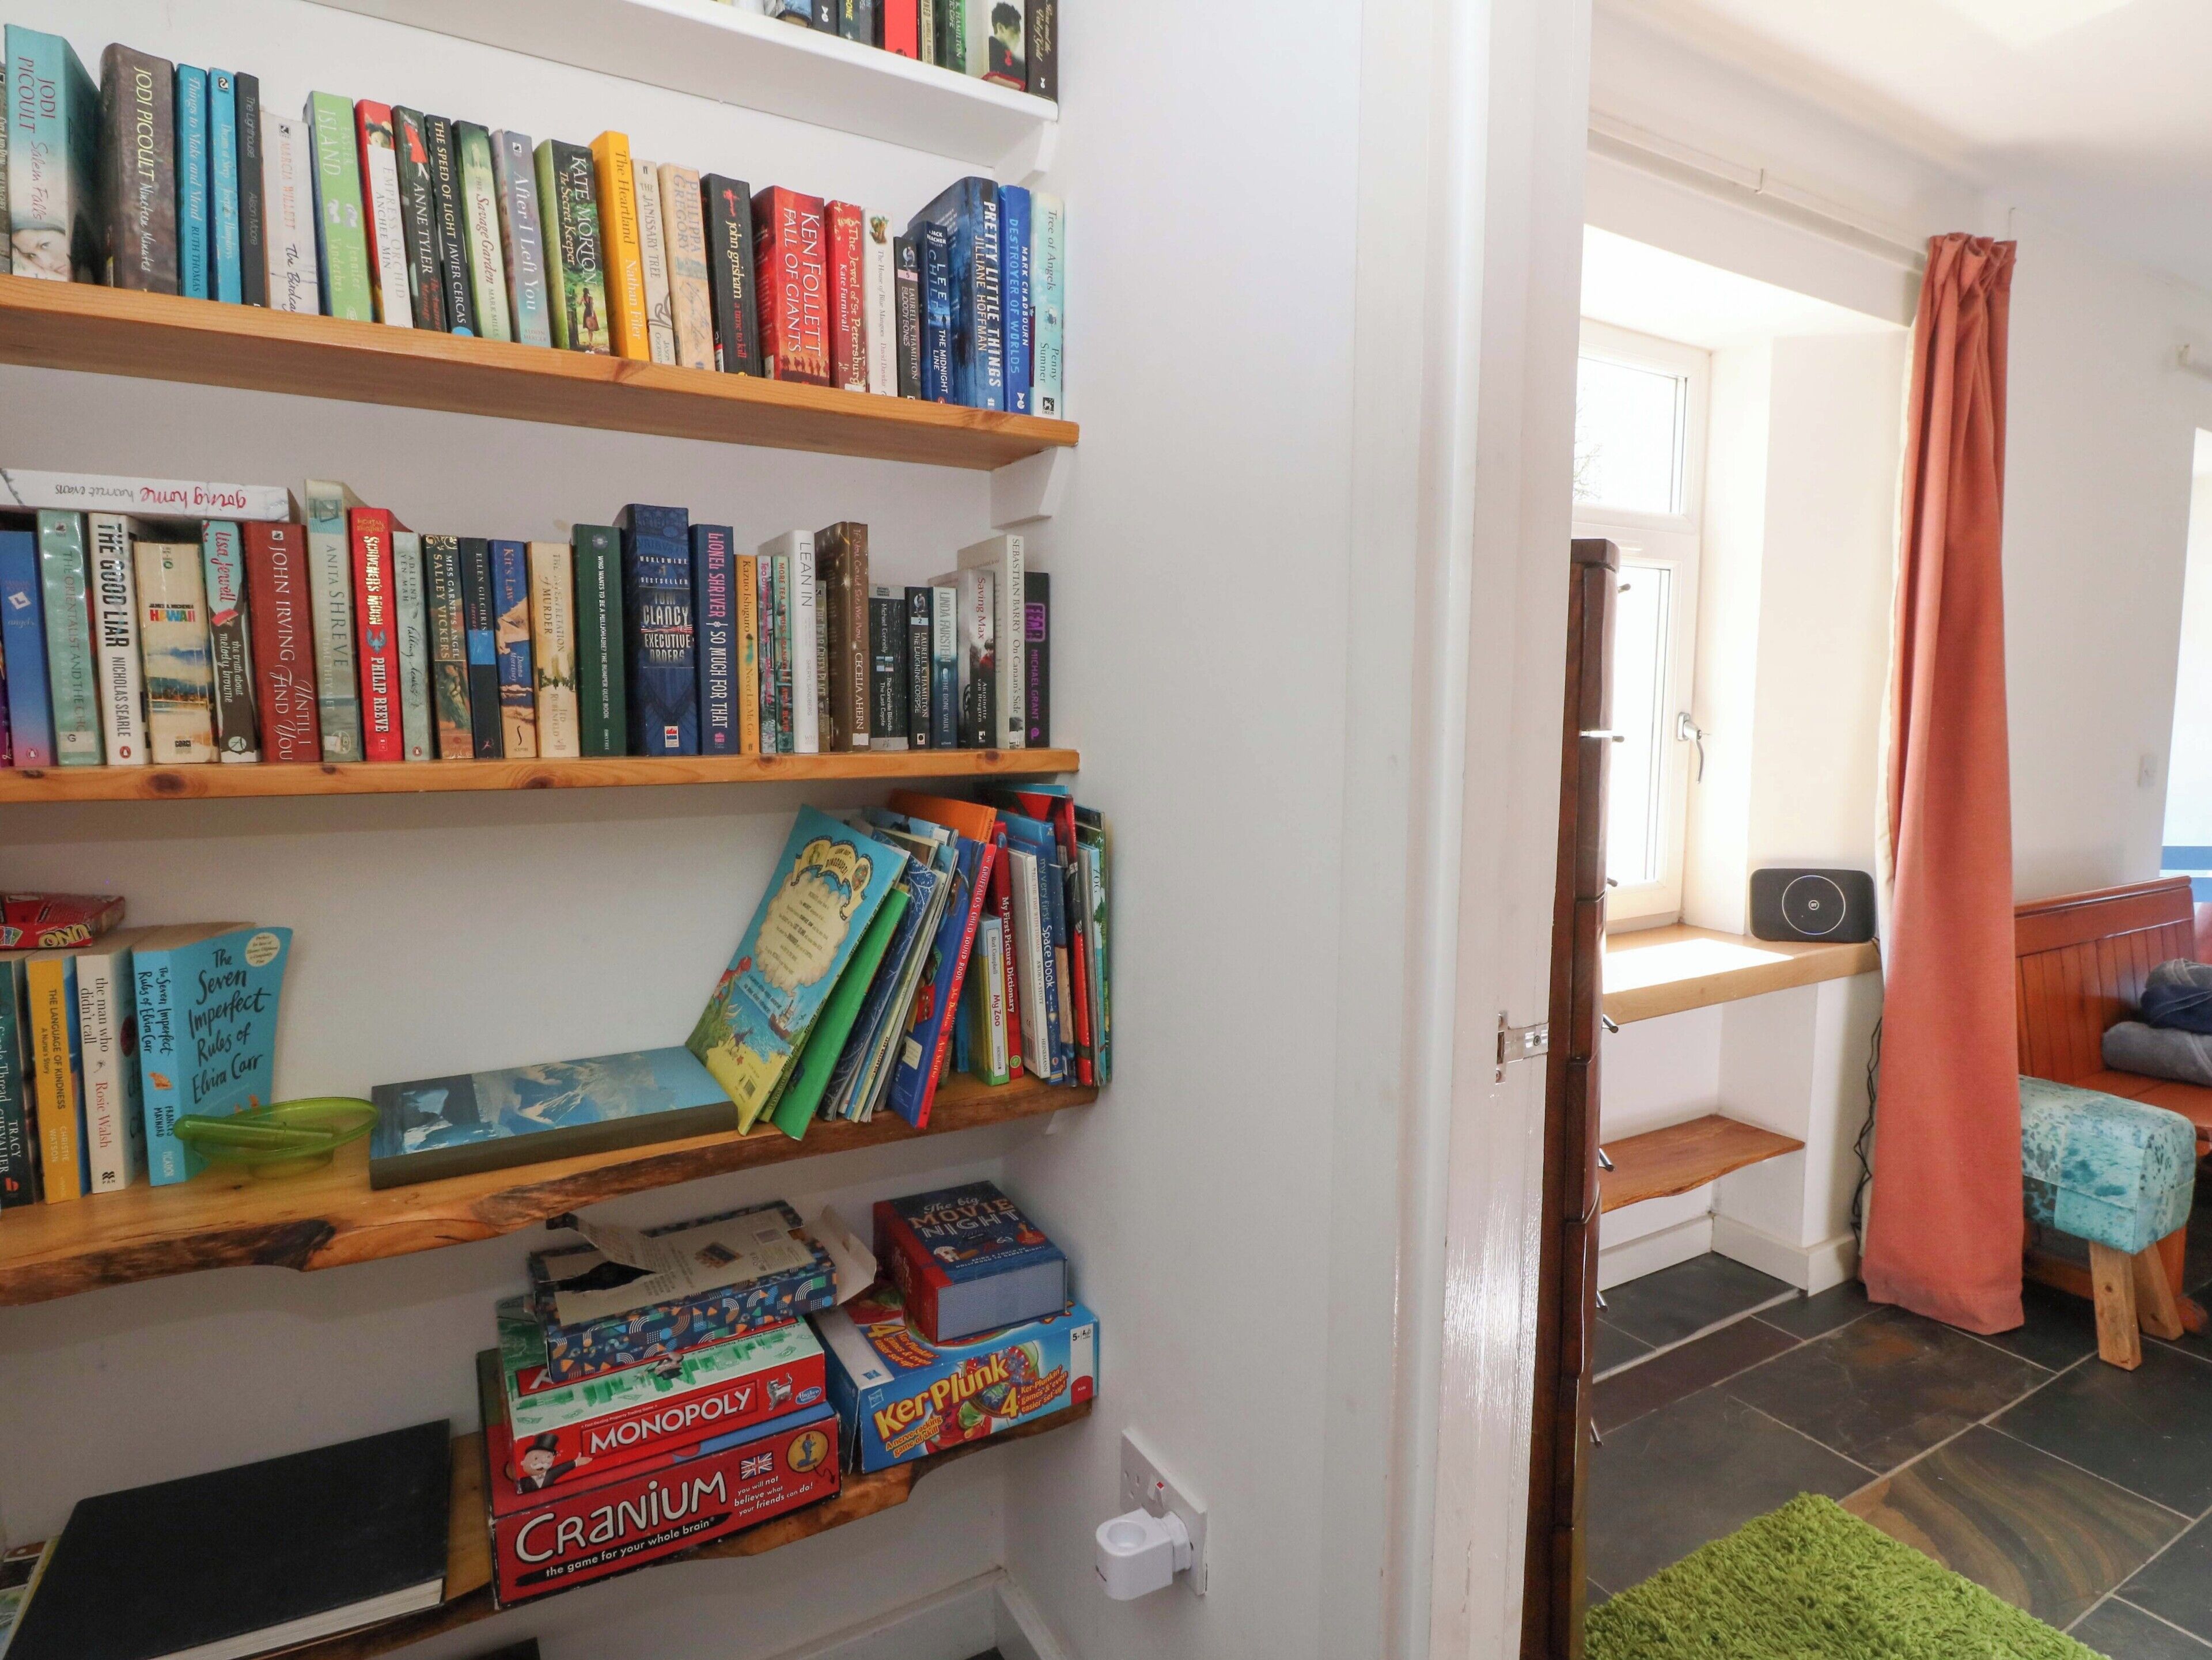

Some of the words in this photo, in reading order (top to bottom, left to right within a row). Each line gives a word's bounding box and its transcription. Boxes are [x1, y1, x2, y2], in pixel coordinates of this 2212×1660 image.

[18, 56, 35, 134] PICOULT
[38, 78, 56, 119] JODI
[134, 66, 153, 106] JODI
[137, 109, 154, 181] PICOULT
[319, 109, 342, 175] ISLAND
[435, 121, 445, 144] THE
[437, 147, 449, 182] SPEED
[570, 156, 590, 201] KATE
[615, 151, 628, 176] The
[140, 183, 153, 226] Nineteen
[414, 182, 429, 226] ANNE
[441, 185, 452, 200] OF
[443, 203, 457, 238] LIGHT
[618, 179, 635, 245] Heartland
[673, 174, 689, 253] GREGORY
[685, 179, 701, 252] PHILIPPA
[783, 207, 797, 247] FALL
[576, 205, 597, 286] MORTON
[726, 220, 743, 248] john
[801, 211, 820, 256] KEN
[984, 201, 998, 262] PRETTY
[141, 230, 156, 272] Minutes
[418, 230, 433, 274] TYLER
[446, 242, 461, 278] JAVIER
[785, 253, 799, 280] OF
[975, 236, 986, 289] JILLIANE
[1009, 219, 1019, 294] DESTROYER
[626, 259, 639, 306] Nathan
[727, 249, 745, 299] grisham
[839, 263, 847, 286] Kate
[453, 282, 467, 324] CERCAS
[802, 261, 821, 357] FOLLETT
[840, 287, 850, 332] Furnivall
[986, 267, 1000, 321] LITTLE
[1010, 300, 1019, 316] OF
[631, 310, 643, 340] Filer
[786, 283, 802, 353] GIANTS
[976, 294, 987, 351] HOFFMAN
[987, 329, 1001, 388] THINGS
[1010, 321, 1020, 374] WORLDS
[1040, 343, 1050, 383] Sumner
[1051, 348, 1060, 381] Penny
[940, 348, 948, 394] MIDNIGHT
[97, 523, 124, 555] THE
[709, 532, 725, 569] LIONEL
[267, 545, 290, 593] JOHN
[326, 544, 339, 585] ANITA
[433, 554, 446, 601] SALLEY
[446, 555, 454, 577] MISS
[639, 556, 687, 564] WORLDWIDE
[743, 560, 751, 591] Kazuo
[800, 542, 812, 585] LEAN
[1012, 538, 1020, 597] SEBASTIAN
[100, 559, 127, 606] GOOD
[599, 591, 605, 599] TO
[641, 577, 688, 585] BESTSELLER
[708, 573, 726, 618] SHRIVER
[801, 592, 812, 607] IN
[976, 577, 986, 613] Saving
[150, 609, 196, 622] HAWAII
[446, 580, 457, 626] GARNET'S
[741, 594, 752, 632] Ishiguro
[940, 592, 950, 618] LINDA
[1012, 599, 1021, 632] BARRY
[104, 611, 130, 647] LIAR
[275, 601, 295, 661] IRVING
[329, 590, 349, 667] SHREVE
[437, 605, 450, 659] VICKERS
[451, 628, 460, 658] ANGEL
[710, 631, 726, 644] SO
[940, 619, 951, 662] FAIRSTEIN
[978, 616, 986, 639] Max
[1013, 639, 1021, 653] On
[112, 657, 127, 702] NICHOLAS
[371, 657, 387, 695] PHILIP
[709, 647, 728, 677] MUCH
[1013, 655, 1021, 693] Canaan's
[709, 679, 728, 699] FOR
[1013, 695, 1021, 714] Side
[115, 704, 131, 737] SEARLE
[373, 697, 389, 733] REEVE
[710, 703, 728, 729] THAT
[1093, 868, 1101, 893] ZOG
[1002, 897, 1009, 910] My
[1002, 911, 1010, 930] First
[38, 923, 92, 948] UNO
[1004, 931, 1013, 965] Picture
[212, 949, 233, 968] The
[49, 988, 58, 1006] THE
[81, 987, 95, 1022] didn't
[96, 977, 108, 995] the
[196, 969, 247, 1006] Seven
[992, 994, 1000, 1009] My
[1006, 967, 1015, 1014] Dictionary
[50, 1007, 62, 1052] LANGUAGE
[97, 999, 108, 1025] man
[188, 987, 272, 1040] Imperfect
[83, 1024, 97, 1044] call
[99, 1028, 112, 1052] who
[197, 1029, 232, 1067] Rules
[236, 1021, 251, 1045] of
[54, 1055, 62, 1066] OF
[192, 1068, 227, 1104] Elvira
[232, 1052, 263, 1080] Carr
[54, 1067, 66, 1111] KINDNESS
[96, 1082, 109, 1113] Rosie
[8, 1120, 21, 1158] TRACY
[98, 1115, 113, 1149] Walsh
[908, 1198, 1014, 1229] MOVIE
[921, 1208, 1020, 1238] NIGHT
[874, 1354, 1009, 1440] KerPlunk
[590, 1388, 751, 1455] MONOPOLY
[734, 1490, 764, 1507] believe
[767, 1485, 783, 1495] what
[546, 1566, 564, 1578] the
[567, 1555, 599, 1574] game
[601, 1548, 618, 1562] for
[620, 1541, 646, 1559] your
[647, 1528, 680, 1547] whole
[682, 1519, 710, 1535] brain
